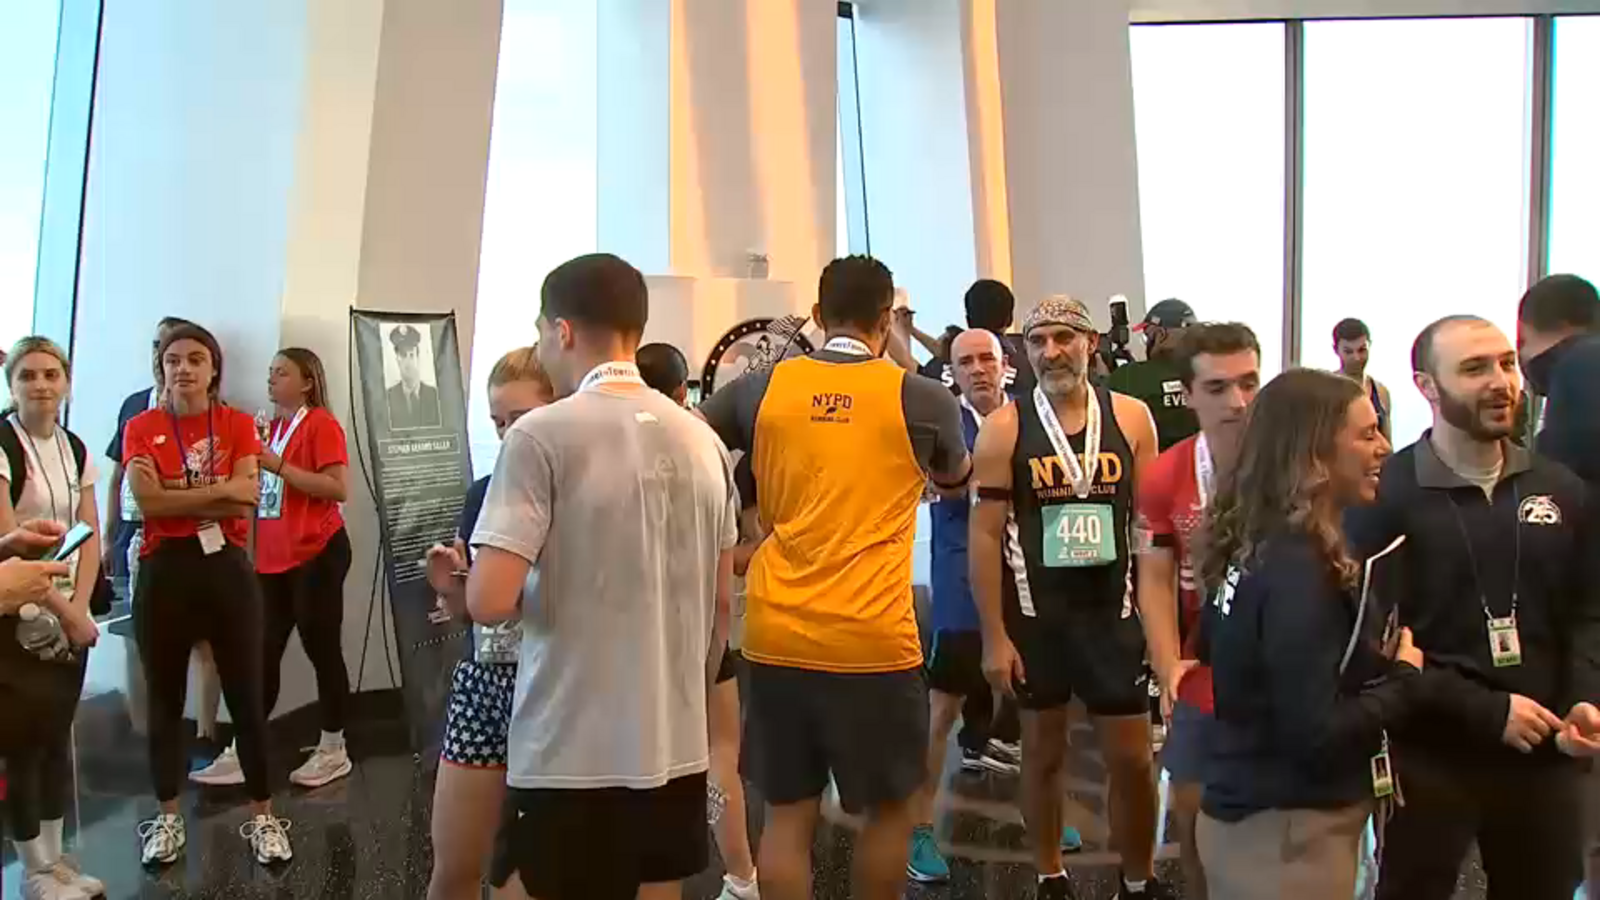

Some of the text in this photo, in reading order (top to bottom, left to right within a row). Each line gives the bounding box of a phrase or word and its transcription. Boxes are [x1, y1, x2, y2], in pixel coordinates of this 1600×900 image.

[812, 393, 853, 409] NYPD
[1163, 394, 1188, 406] EVE
[1056, 515, 1101, 544] 440
